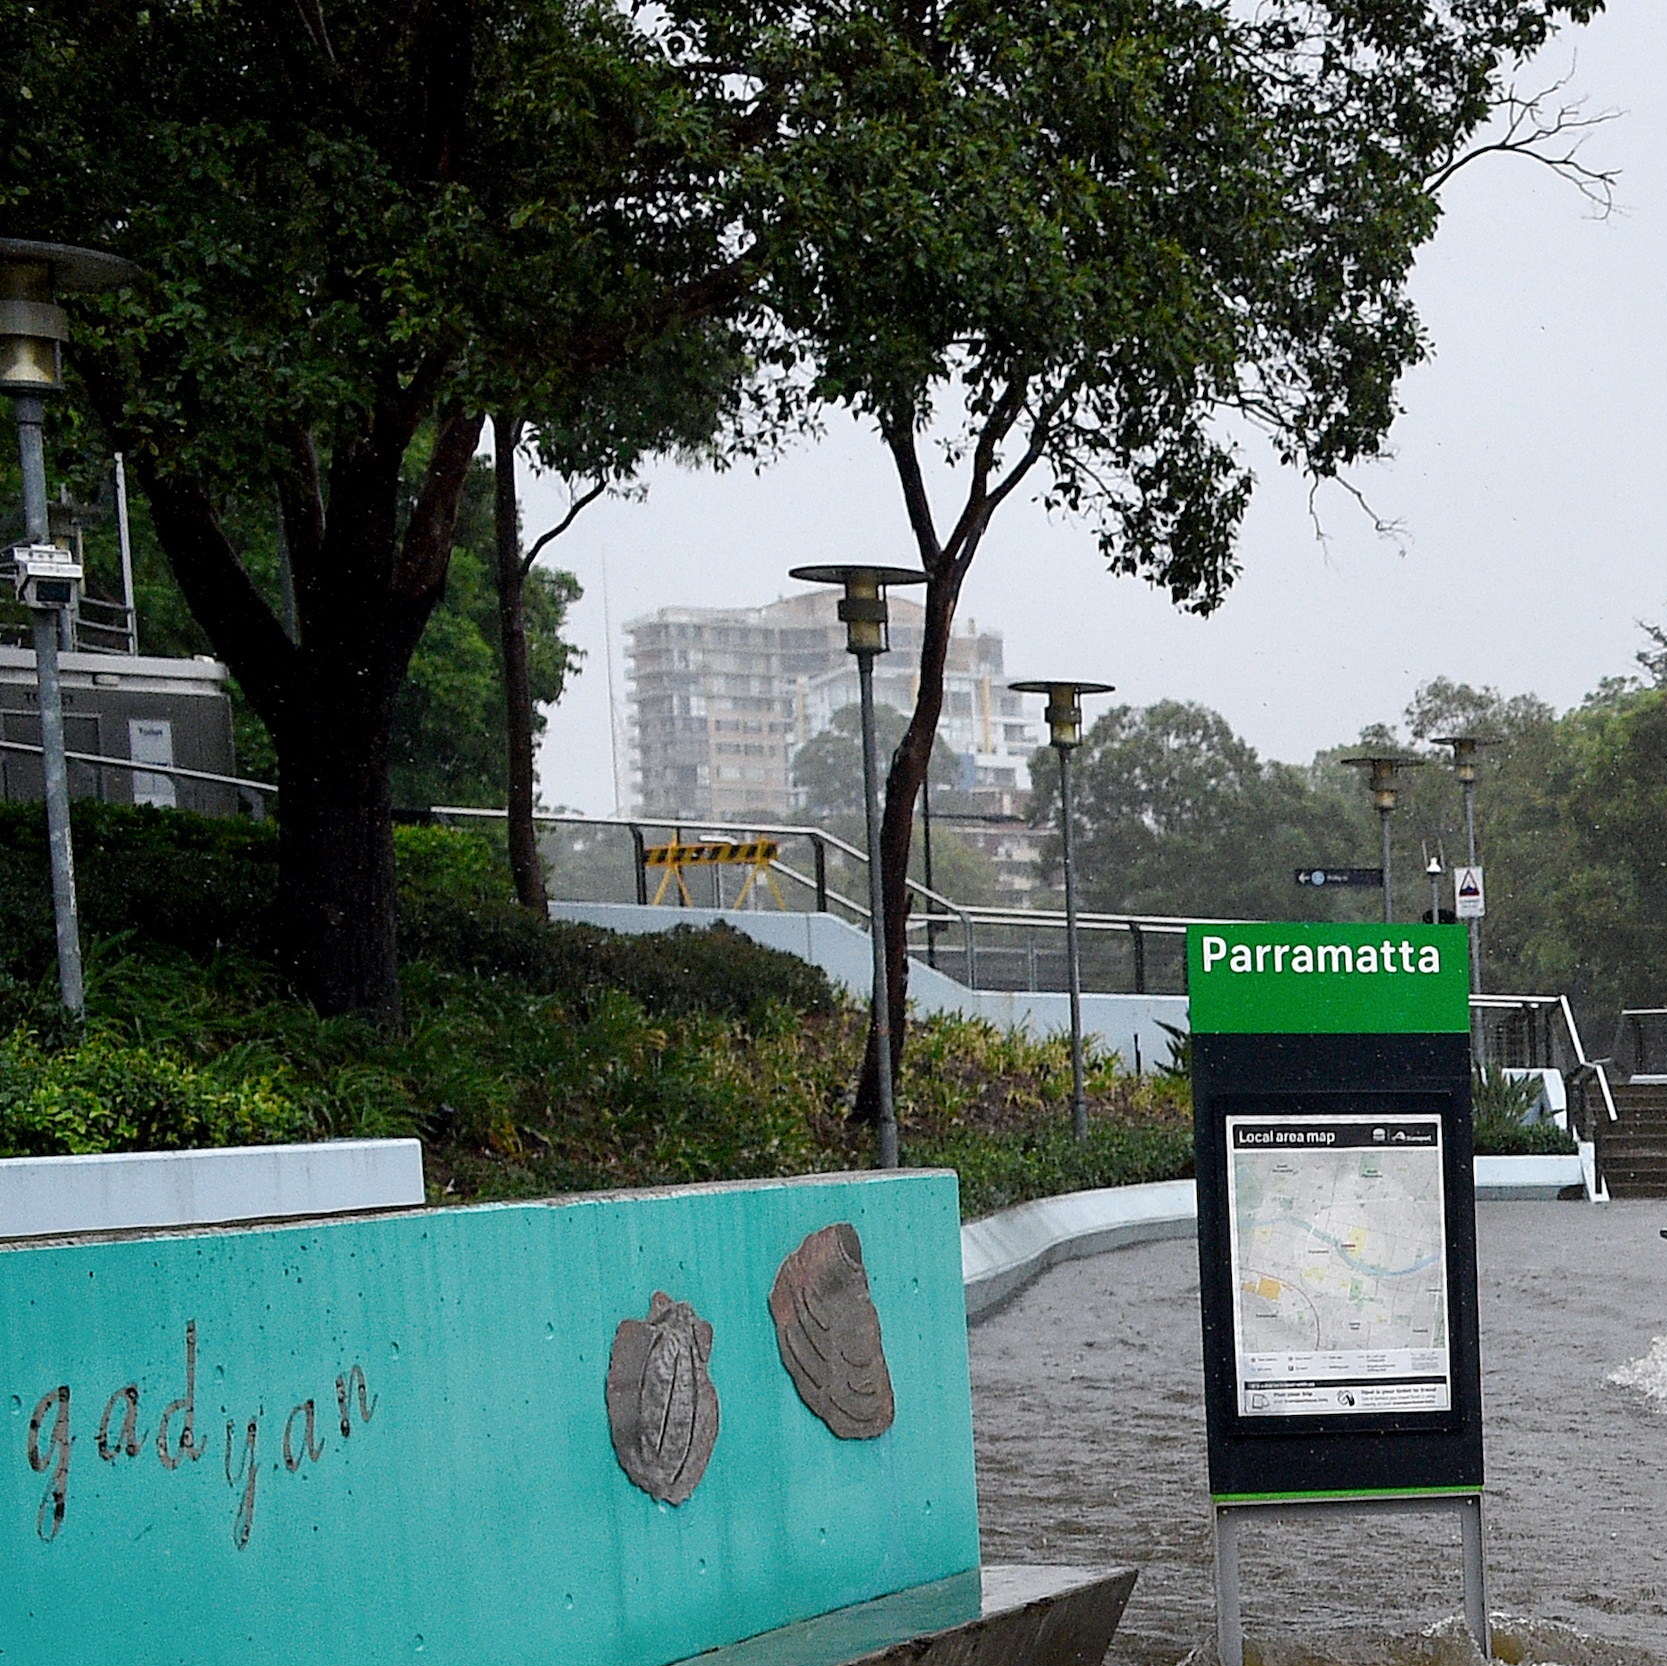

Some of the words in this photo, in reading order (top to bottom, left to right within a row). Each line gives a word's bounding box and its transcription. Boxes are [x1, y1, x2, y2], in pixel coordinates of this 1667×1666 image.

[1202, 935, 1440, 973] Parramatta
[1239, 1130, 1273, 1143] Local
[1276, 1132, 1304, 1142] area
[1306, 1131, 1335, 1144] map
[27, 1319, 378, 1551] gadyan
